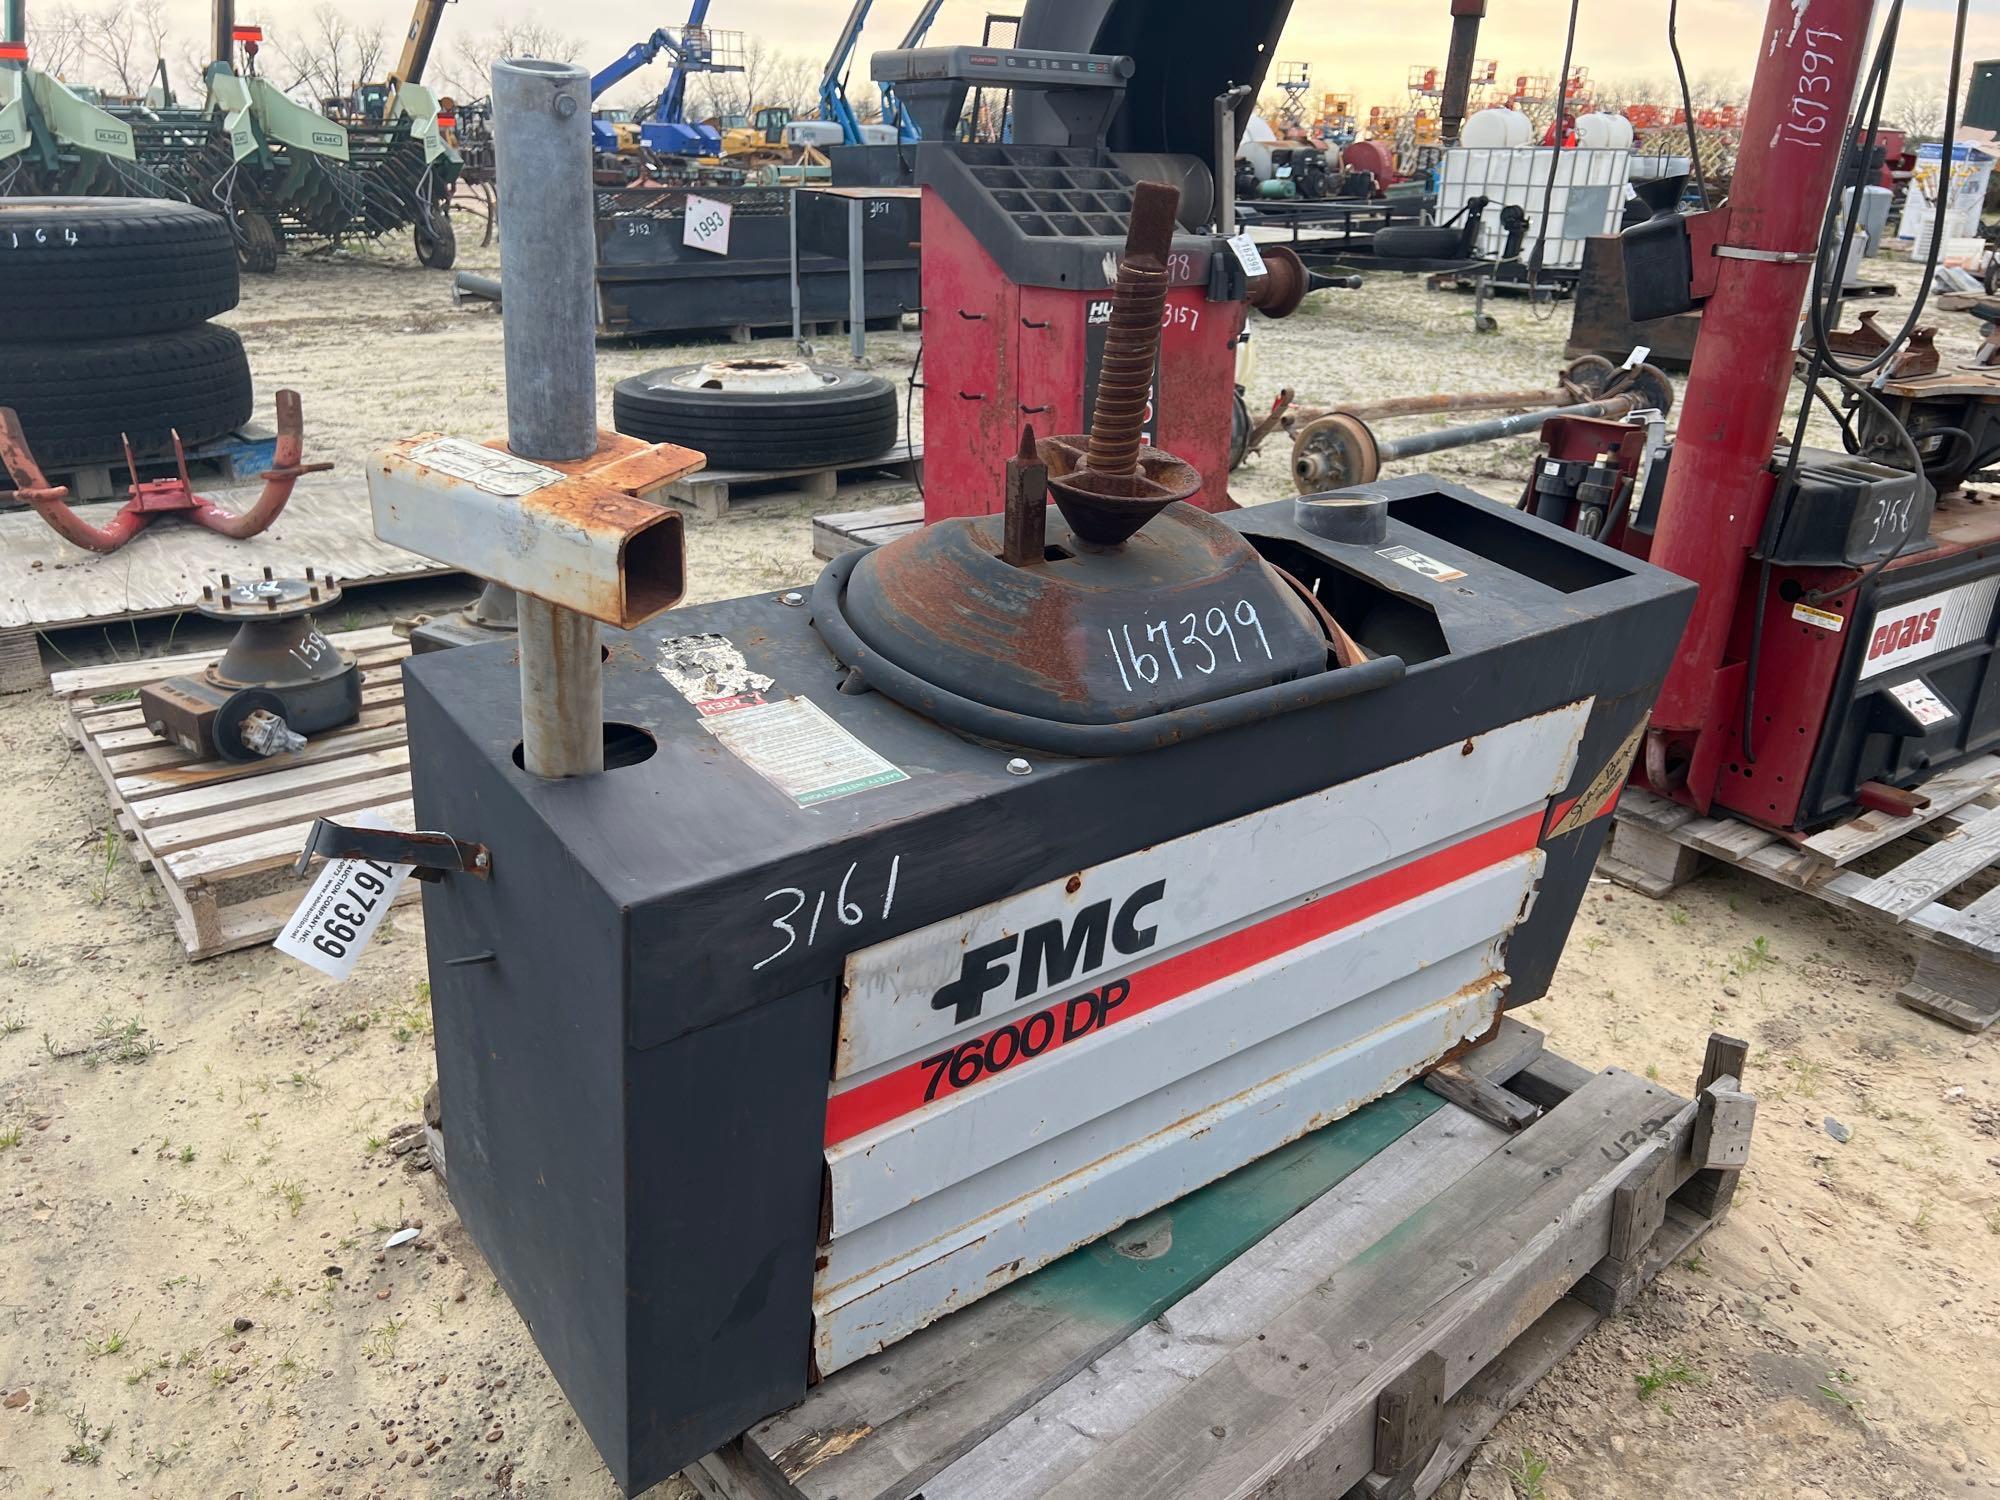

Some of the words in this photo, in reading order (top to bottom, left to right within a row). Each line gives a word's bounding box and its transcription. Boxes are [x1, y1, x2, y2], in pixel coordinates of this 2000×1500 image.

[1784, 28, 1843, 147] 167397
[693, 211, 724, 241] 1993
[1162, 304, 1199, 331] 3157
[1106, 599, 1273, 692] 167399
[309, 895, 334, 930] COMPANY
[313, 860, 394, 958] 167399
[332, 864, 354, 896] AUCTION
[752, 854, 901, 970] 3161
[920, 1009, 1055, 1100] 7600
[1062, 978, 1131, 1048] DP
